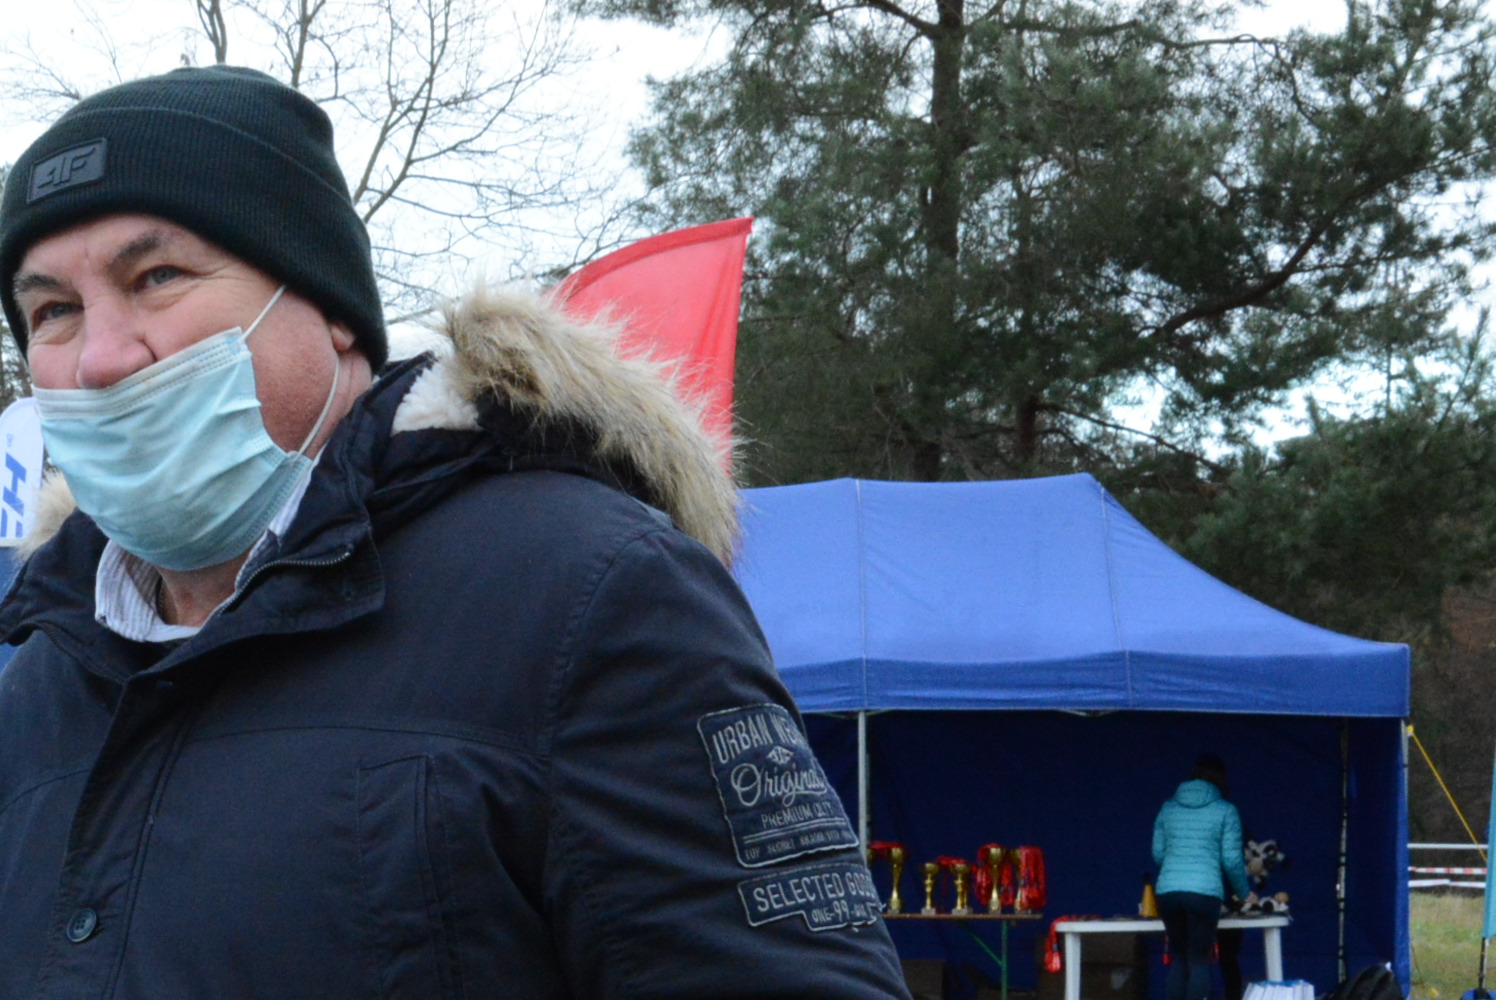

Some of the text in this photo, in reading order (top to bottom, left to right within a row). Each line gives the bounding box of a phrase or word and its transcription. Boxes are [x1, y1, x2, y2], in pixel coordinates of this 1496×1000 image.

[712, 712, 774, 764] URBAN
[761, 805, 812, 828] PREMIUM
[753, 872, 846, 912] SELECTED
